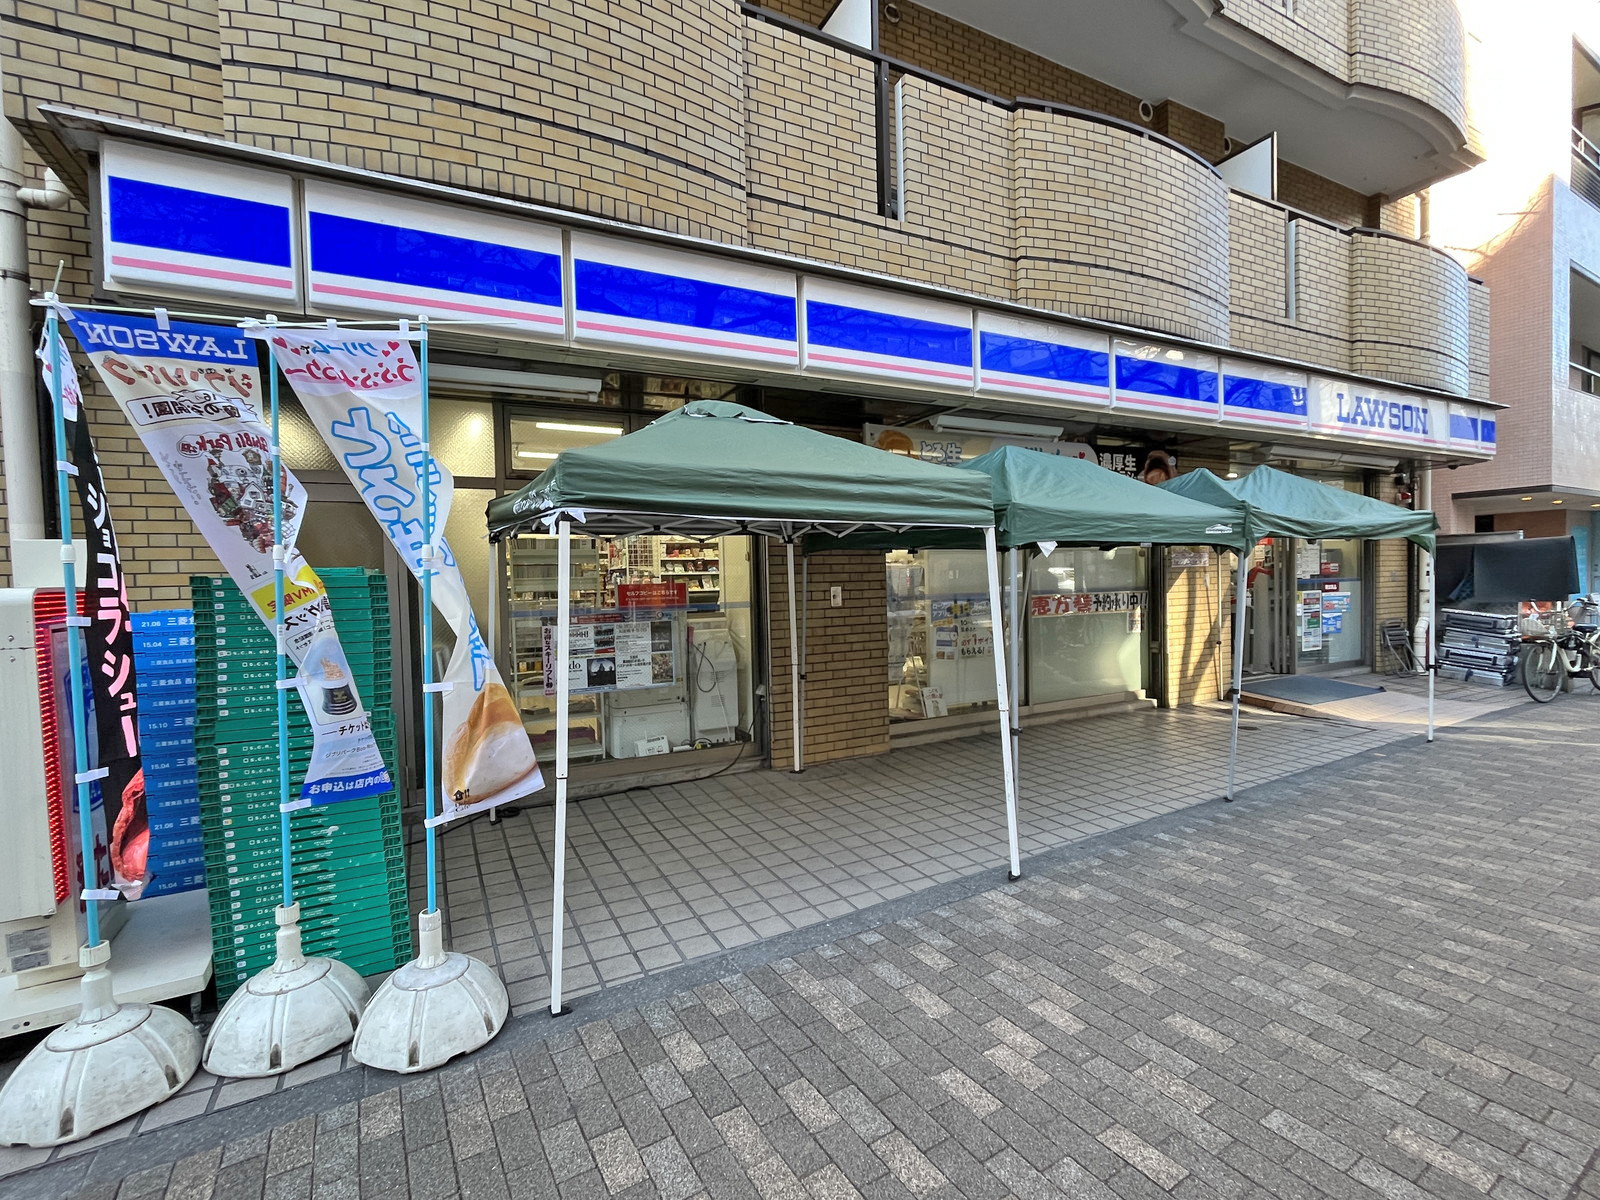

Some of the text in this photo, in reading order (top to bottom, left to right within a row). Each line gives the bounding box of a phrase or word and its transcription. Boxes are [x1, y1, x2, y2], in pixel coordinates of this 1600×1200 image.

[1337, 393, 1428, 435] LAWSON
[920, 441, 962, 464] とろ生
[1100, 453, 1137, 472] 濃厚生
[626, 589, 678, 597] セルフコピーはこちらです
[87, 482, 137, 758] ショコラシュー
